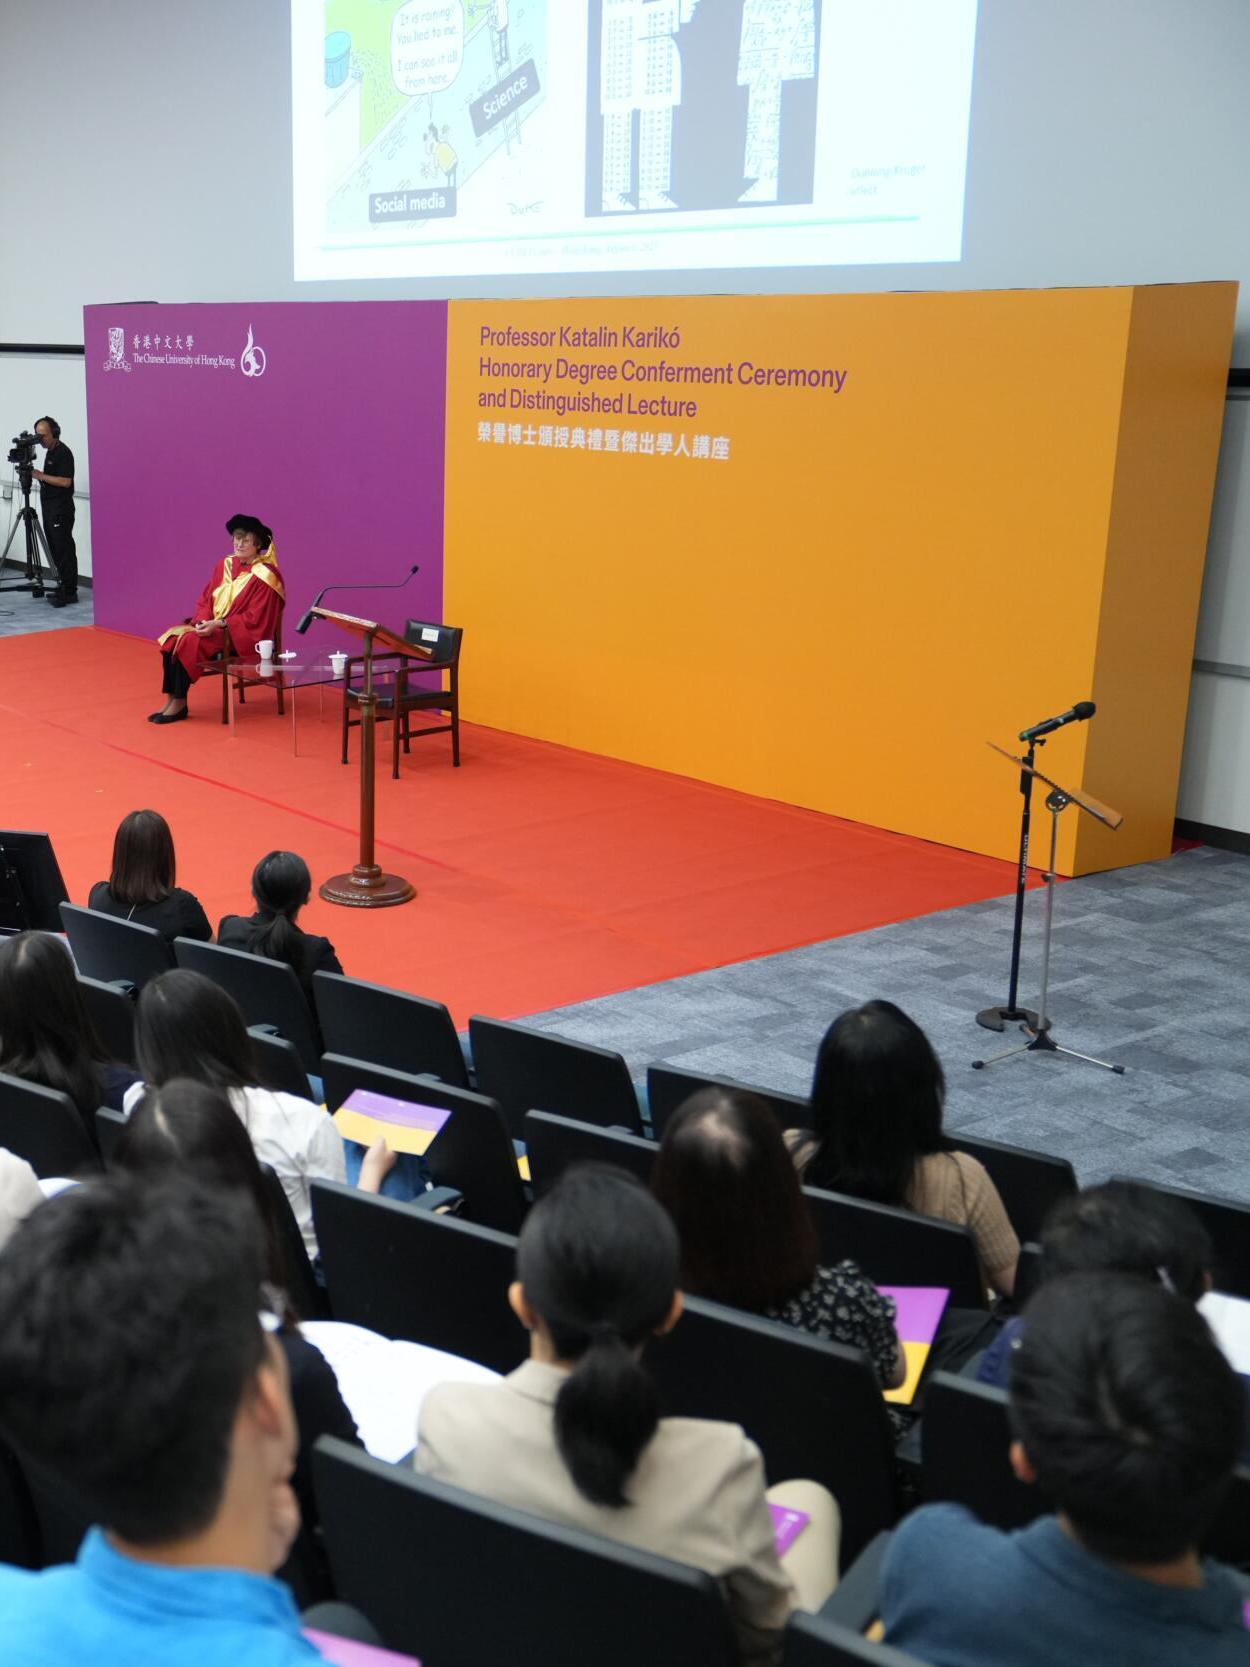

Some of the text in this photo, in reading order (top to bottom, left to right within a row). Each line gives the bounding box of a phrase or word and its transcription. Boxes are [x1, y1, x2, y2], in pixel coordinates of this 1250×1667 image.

[405, 75, 426, 89] from
[482, 76, 529, 120] Science
[374, 191, 446, 214] Social media
[132, 334, 195, 351] 香港中文大學
[480, 326, 680, 349] Professor Katalin Karikó
[132, 352, 236, 370] The Chinese University of Hong Kong
[479, 356, 848, 394] Honorary Degree Conferment Ceremony
[478, 387, 698, 418] and Distinguished Lecture
[477, 420, 731, 461] 榮譽博士頒授典禮暨傑出學人講座
